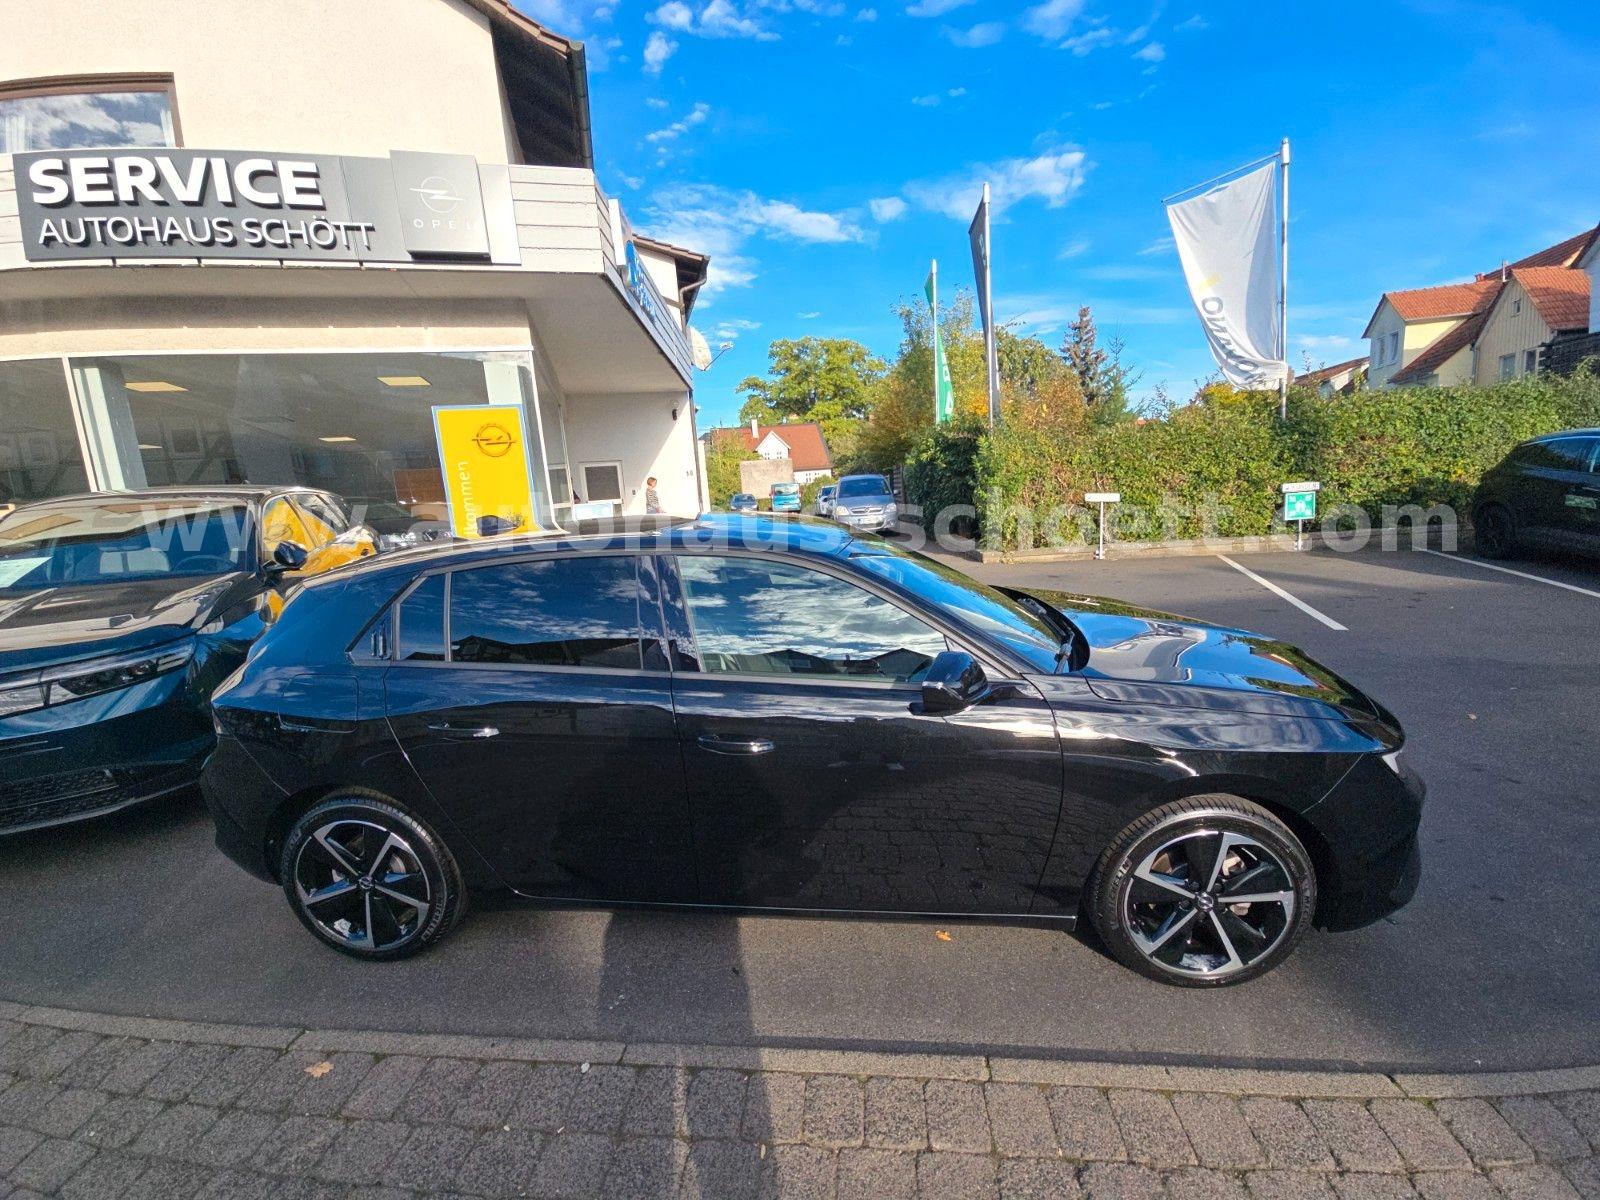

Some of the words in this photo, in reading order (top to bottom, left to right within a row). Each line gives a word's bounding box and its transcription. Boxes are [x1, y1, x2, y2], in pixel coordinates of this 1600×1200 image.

[28, 156, 325, 207] SERVICE
[38, 216, 234, 245] AUTOHAUS
[241, 214, 376, 251] SCHÖTT
[413, 218, 475, 230] OPEL
